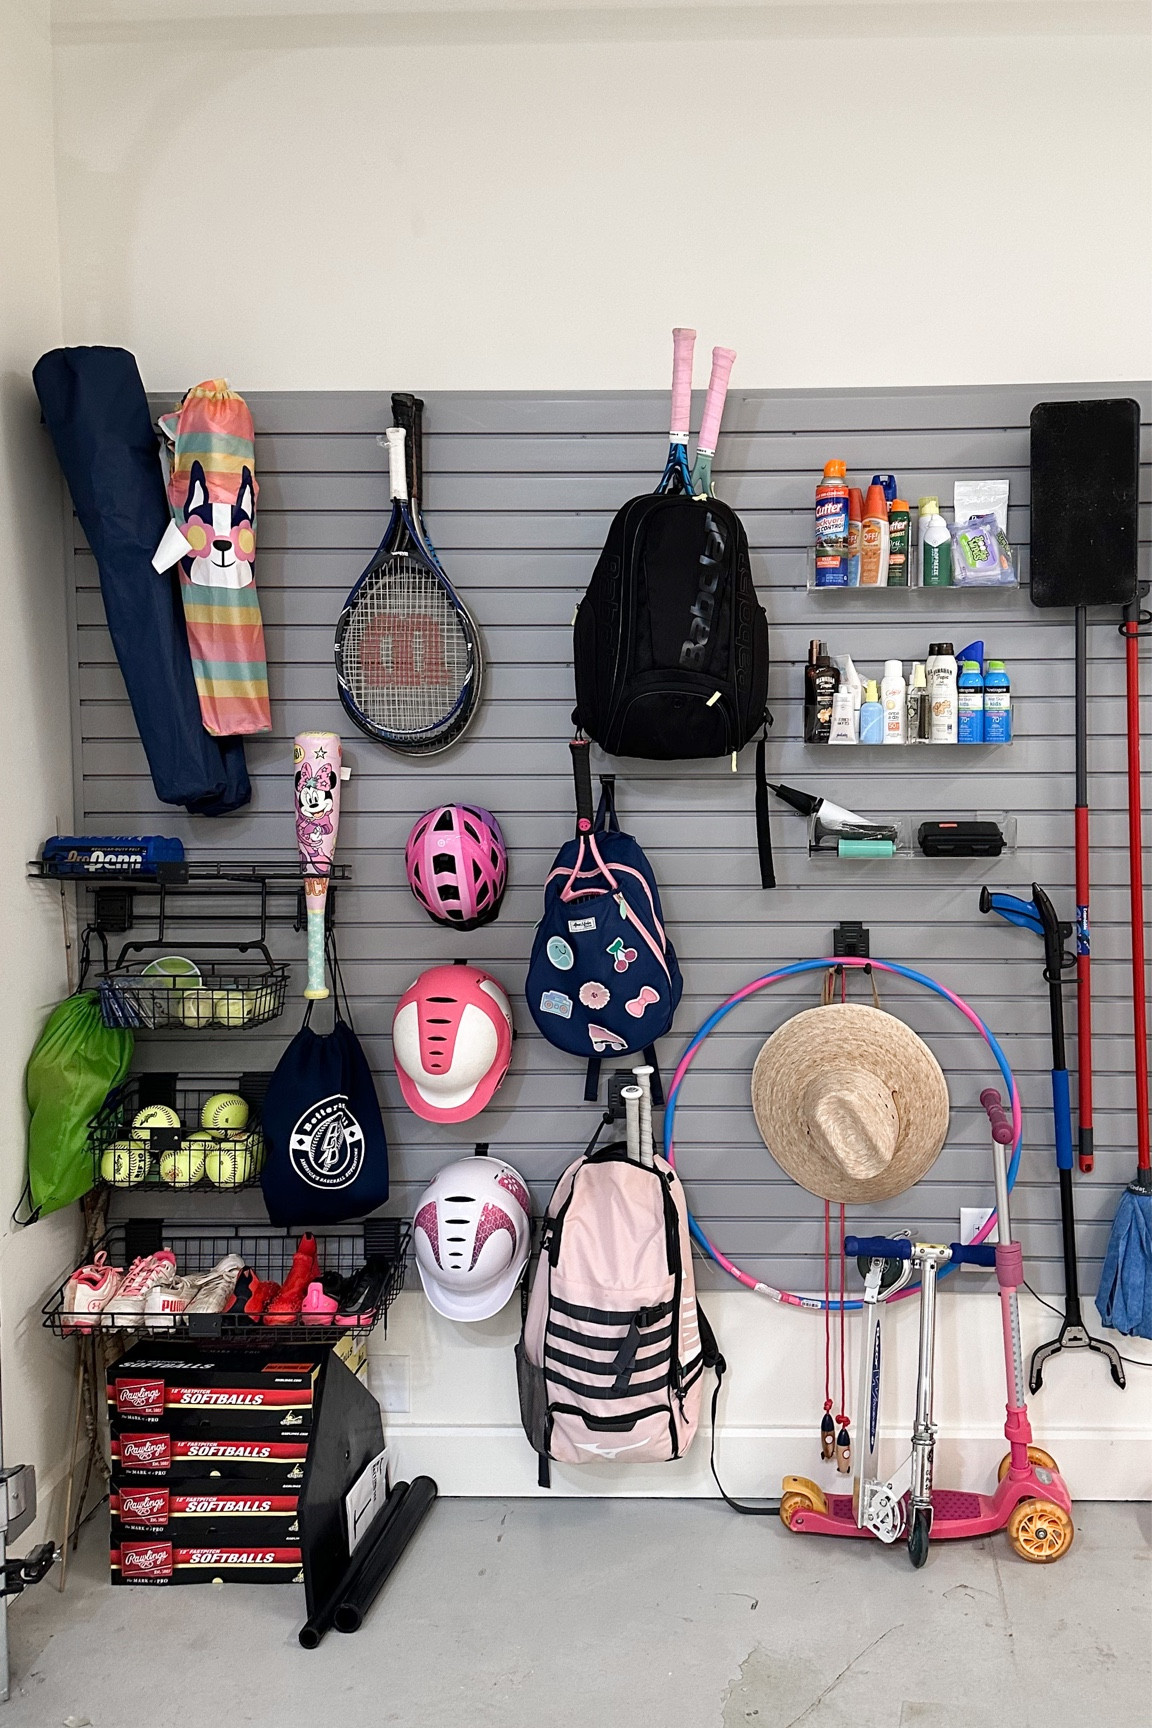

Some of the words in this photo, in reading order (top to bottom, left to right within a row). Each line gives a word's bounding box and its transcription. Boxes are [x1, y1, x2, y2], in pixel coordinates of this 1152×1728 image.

[816, 502, 843, 517] Cutter
[848, 535, 857, 543] FF!
[863, 532, 878, 541] OFF!
[679, 511, 728, 671] Babolat
[161, 1299, 186, 1312] PUM
[118, 1361, 216, 1369] SOFTBALLS
[120, 1387, 160, 1403] Rawlings
[180, 1393, 264, 1405] SOFTBALLS
[125, 1441, 167, 1456] Rawlings
[187, 1446, 271, 1458] SOFTBALLS
[124, 1496, 165, 1512] Rawlings
[185, 1501, 271, 1512] SOFTBALLS
[125, 1549, 168, 1565] Rawlings
[189, 1553, 275, 1563] SOFTBALLS
